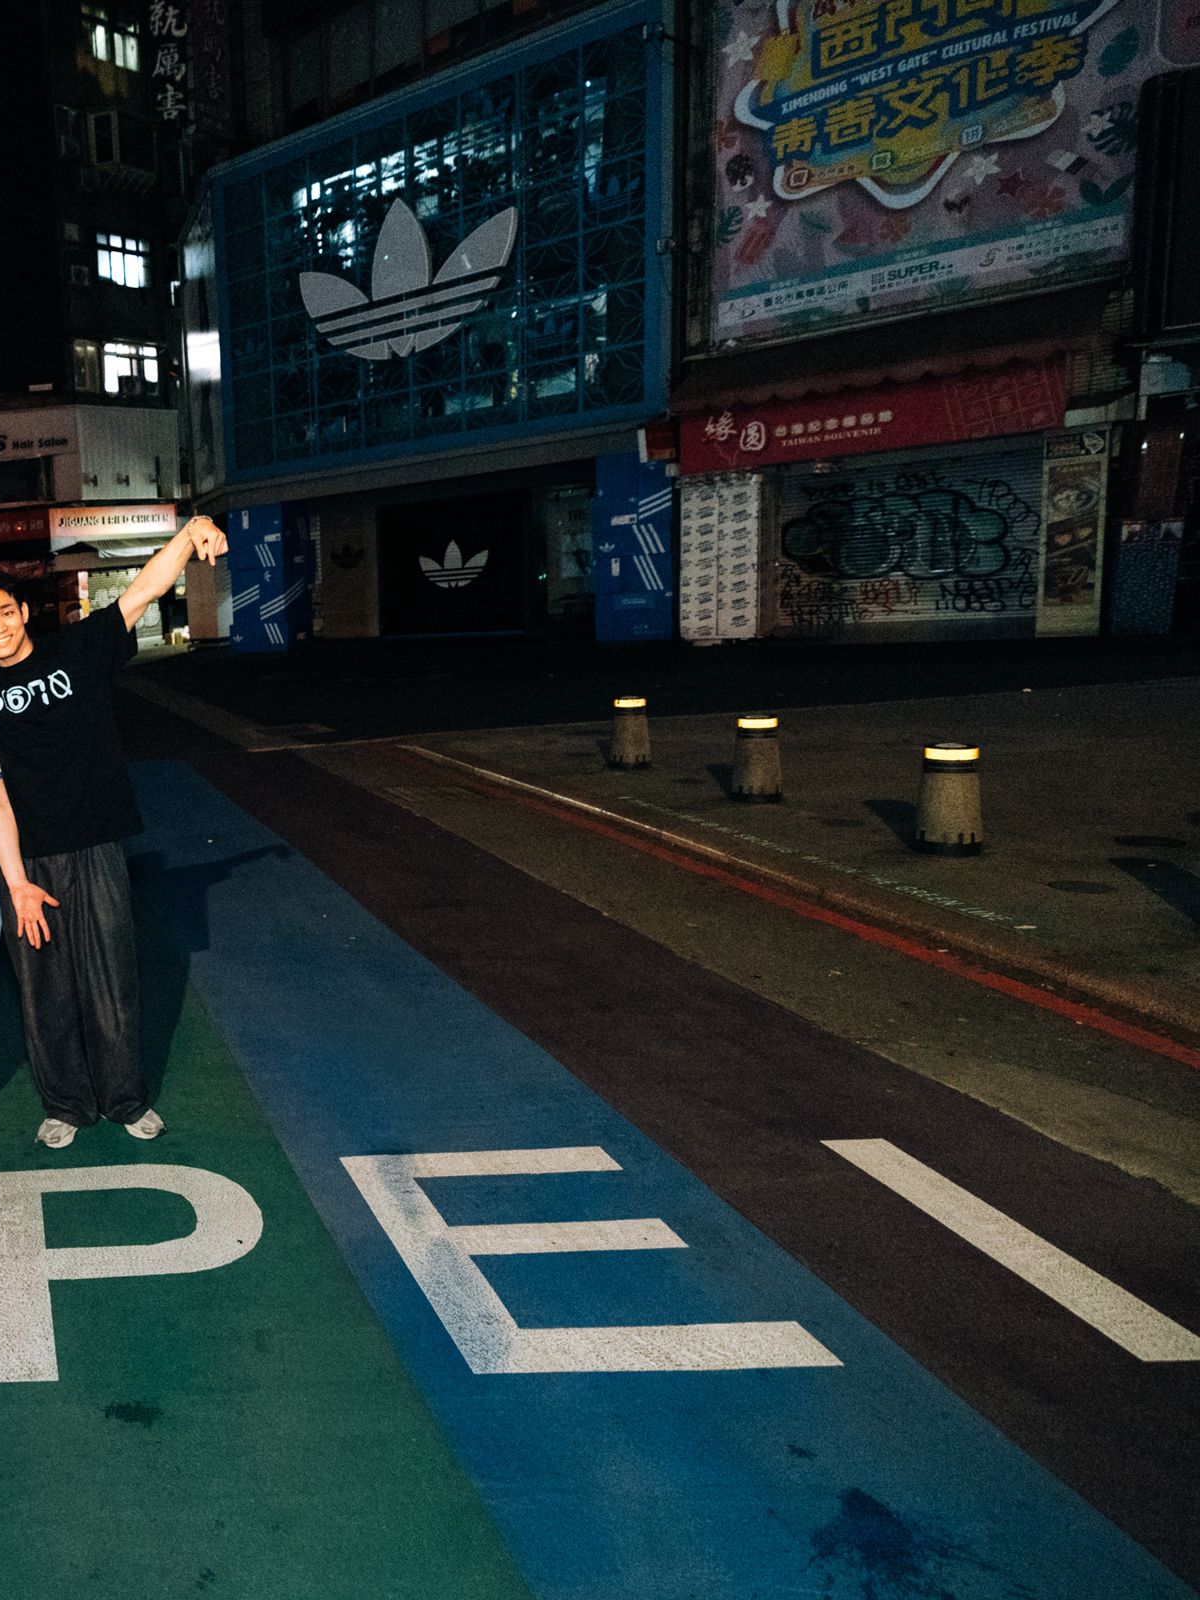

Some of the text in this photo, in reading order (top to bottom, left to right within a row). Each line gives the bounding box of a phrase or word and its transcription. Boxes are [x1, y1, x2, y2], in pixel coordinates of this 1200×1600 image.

[941, 29, 1008, 60] CULTURAL
[1012, 11, 1079, 39] FESTIVAL
[11, 440, 34, 450] Hair
[37, 437, 68, 448] Salon
[781, 436, 822, 448] TAIWAN
[58, 516, 99, 528] JIGUANG
